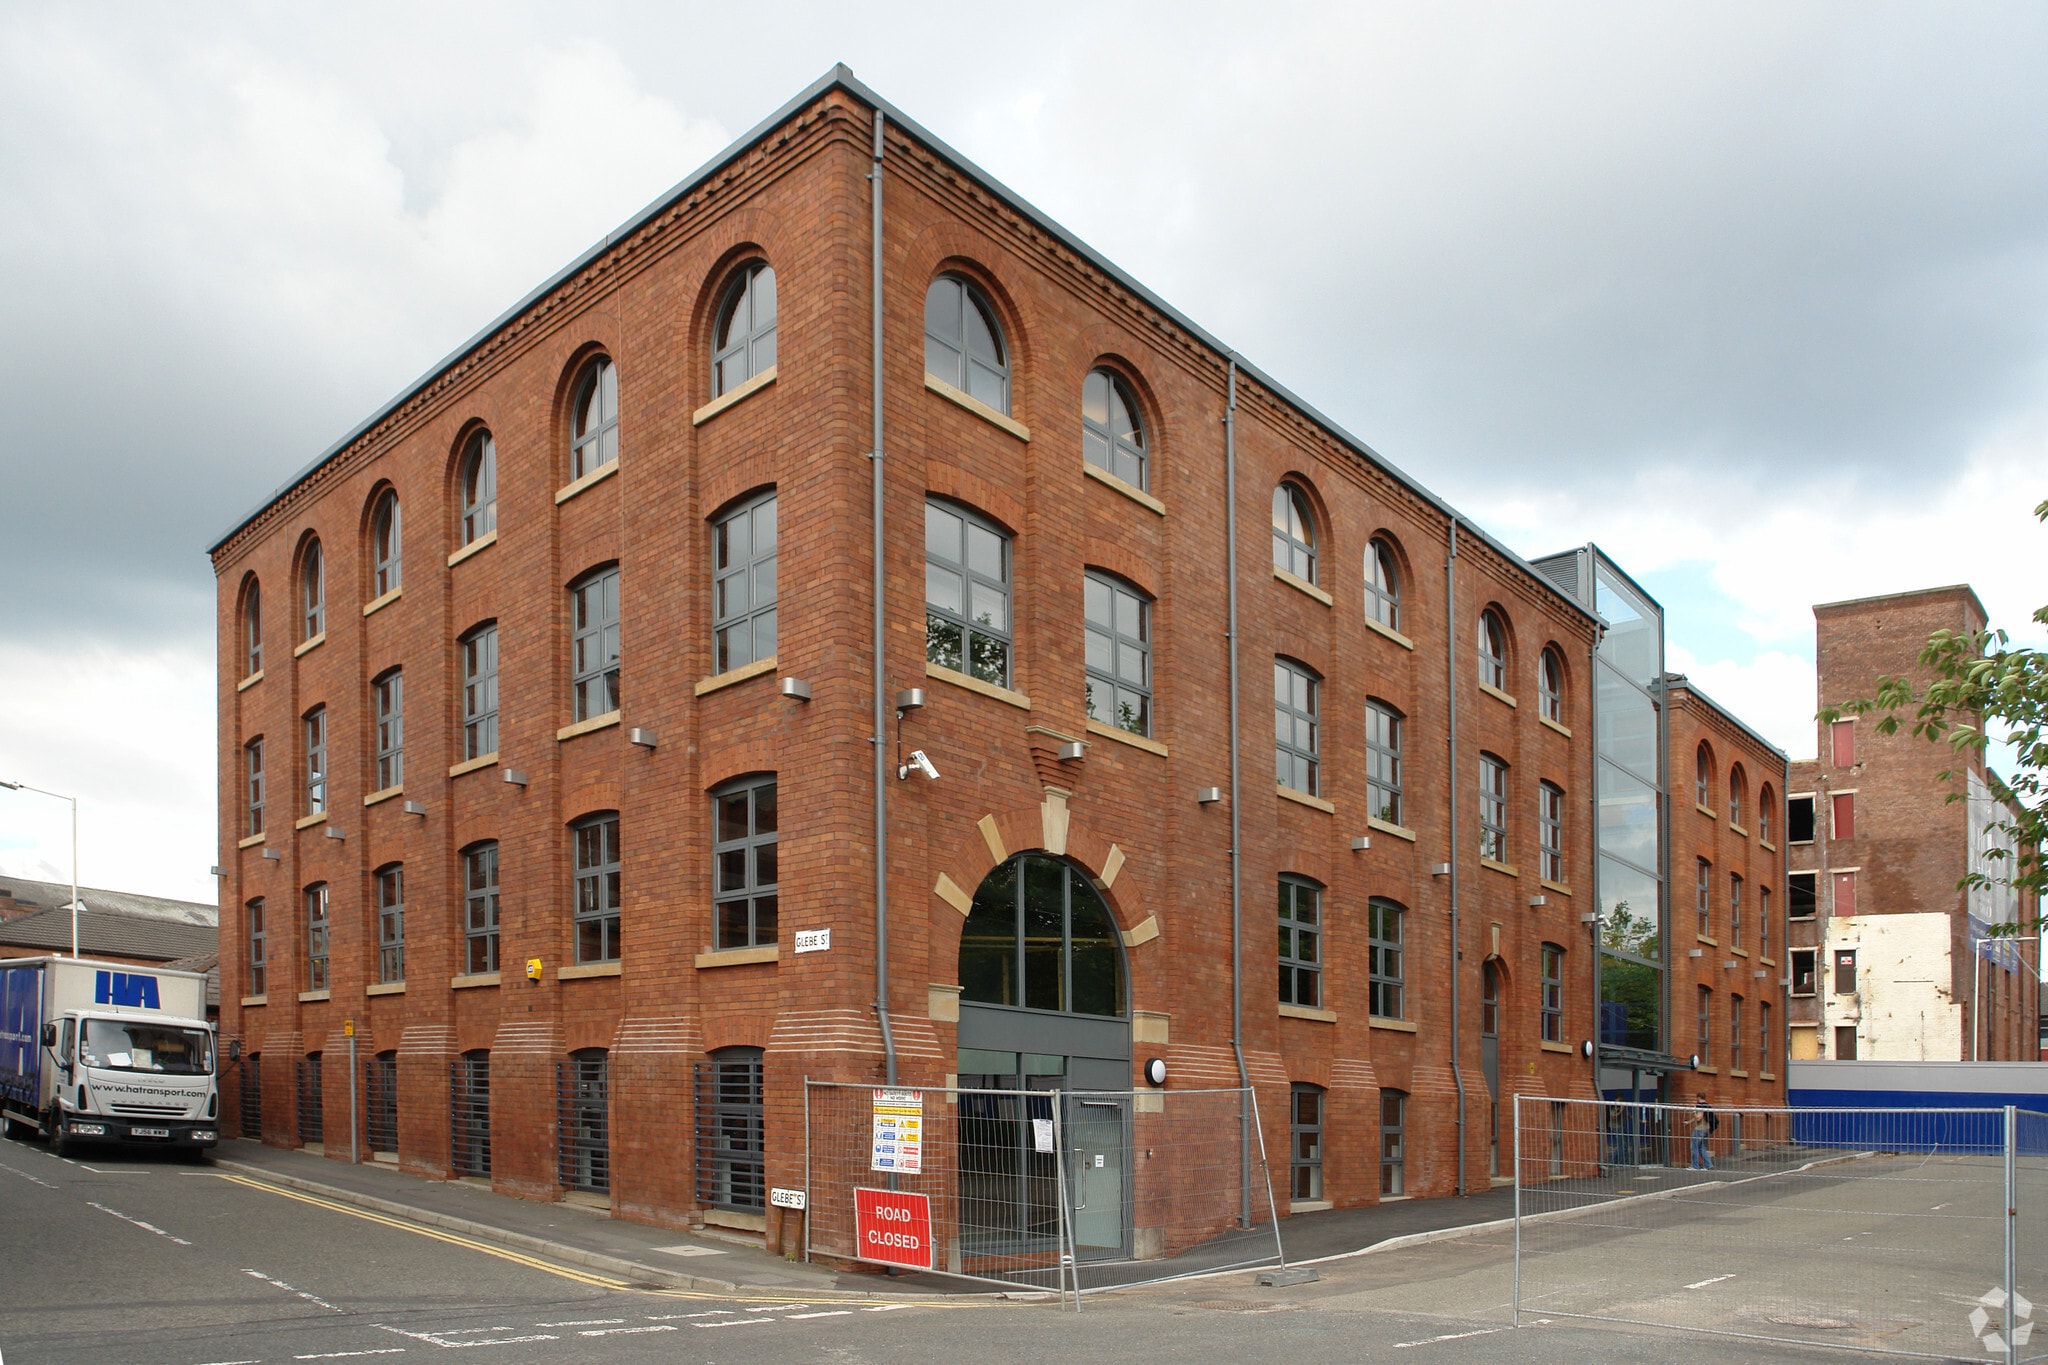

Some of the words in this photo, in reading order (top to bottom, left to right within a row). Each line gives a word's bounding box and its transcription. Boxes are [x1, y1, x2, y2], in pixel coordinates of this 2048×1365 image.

[796, 936, 818, 947] GLEBE
[95, 970, 160, 1009] HA
[91, 1084, 206, 1098] www.hatransport.com
[772, 1191, 794, 1204] GLEBE
[876, 1206, 911, 1222] ROAD
[868, 1230, 919, 1249] CLOSED
